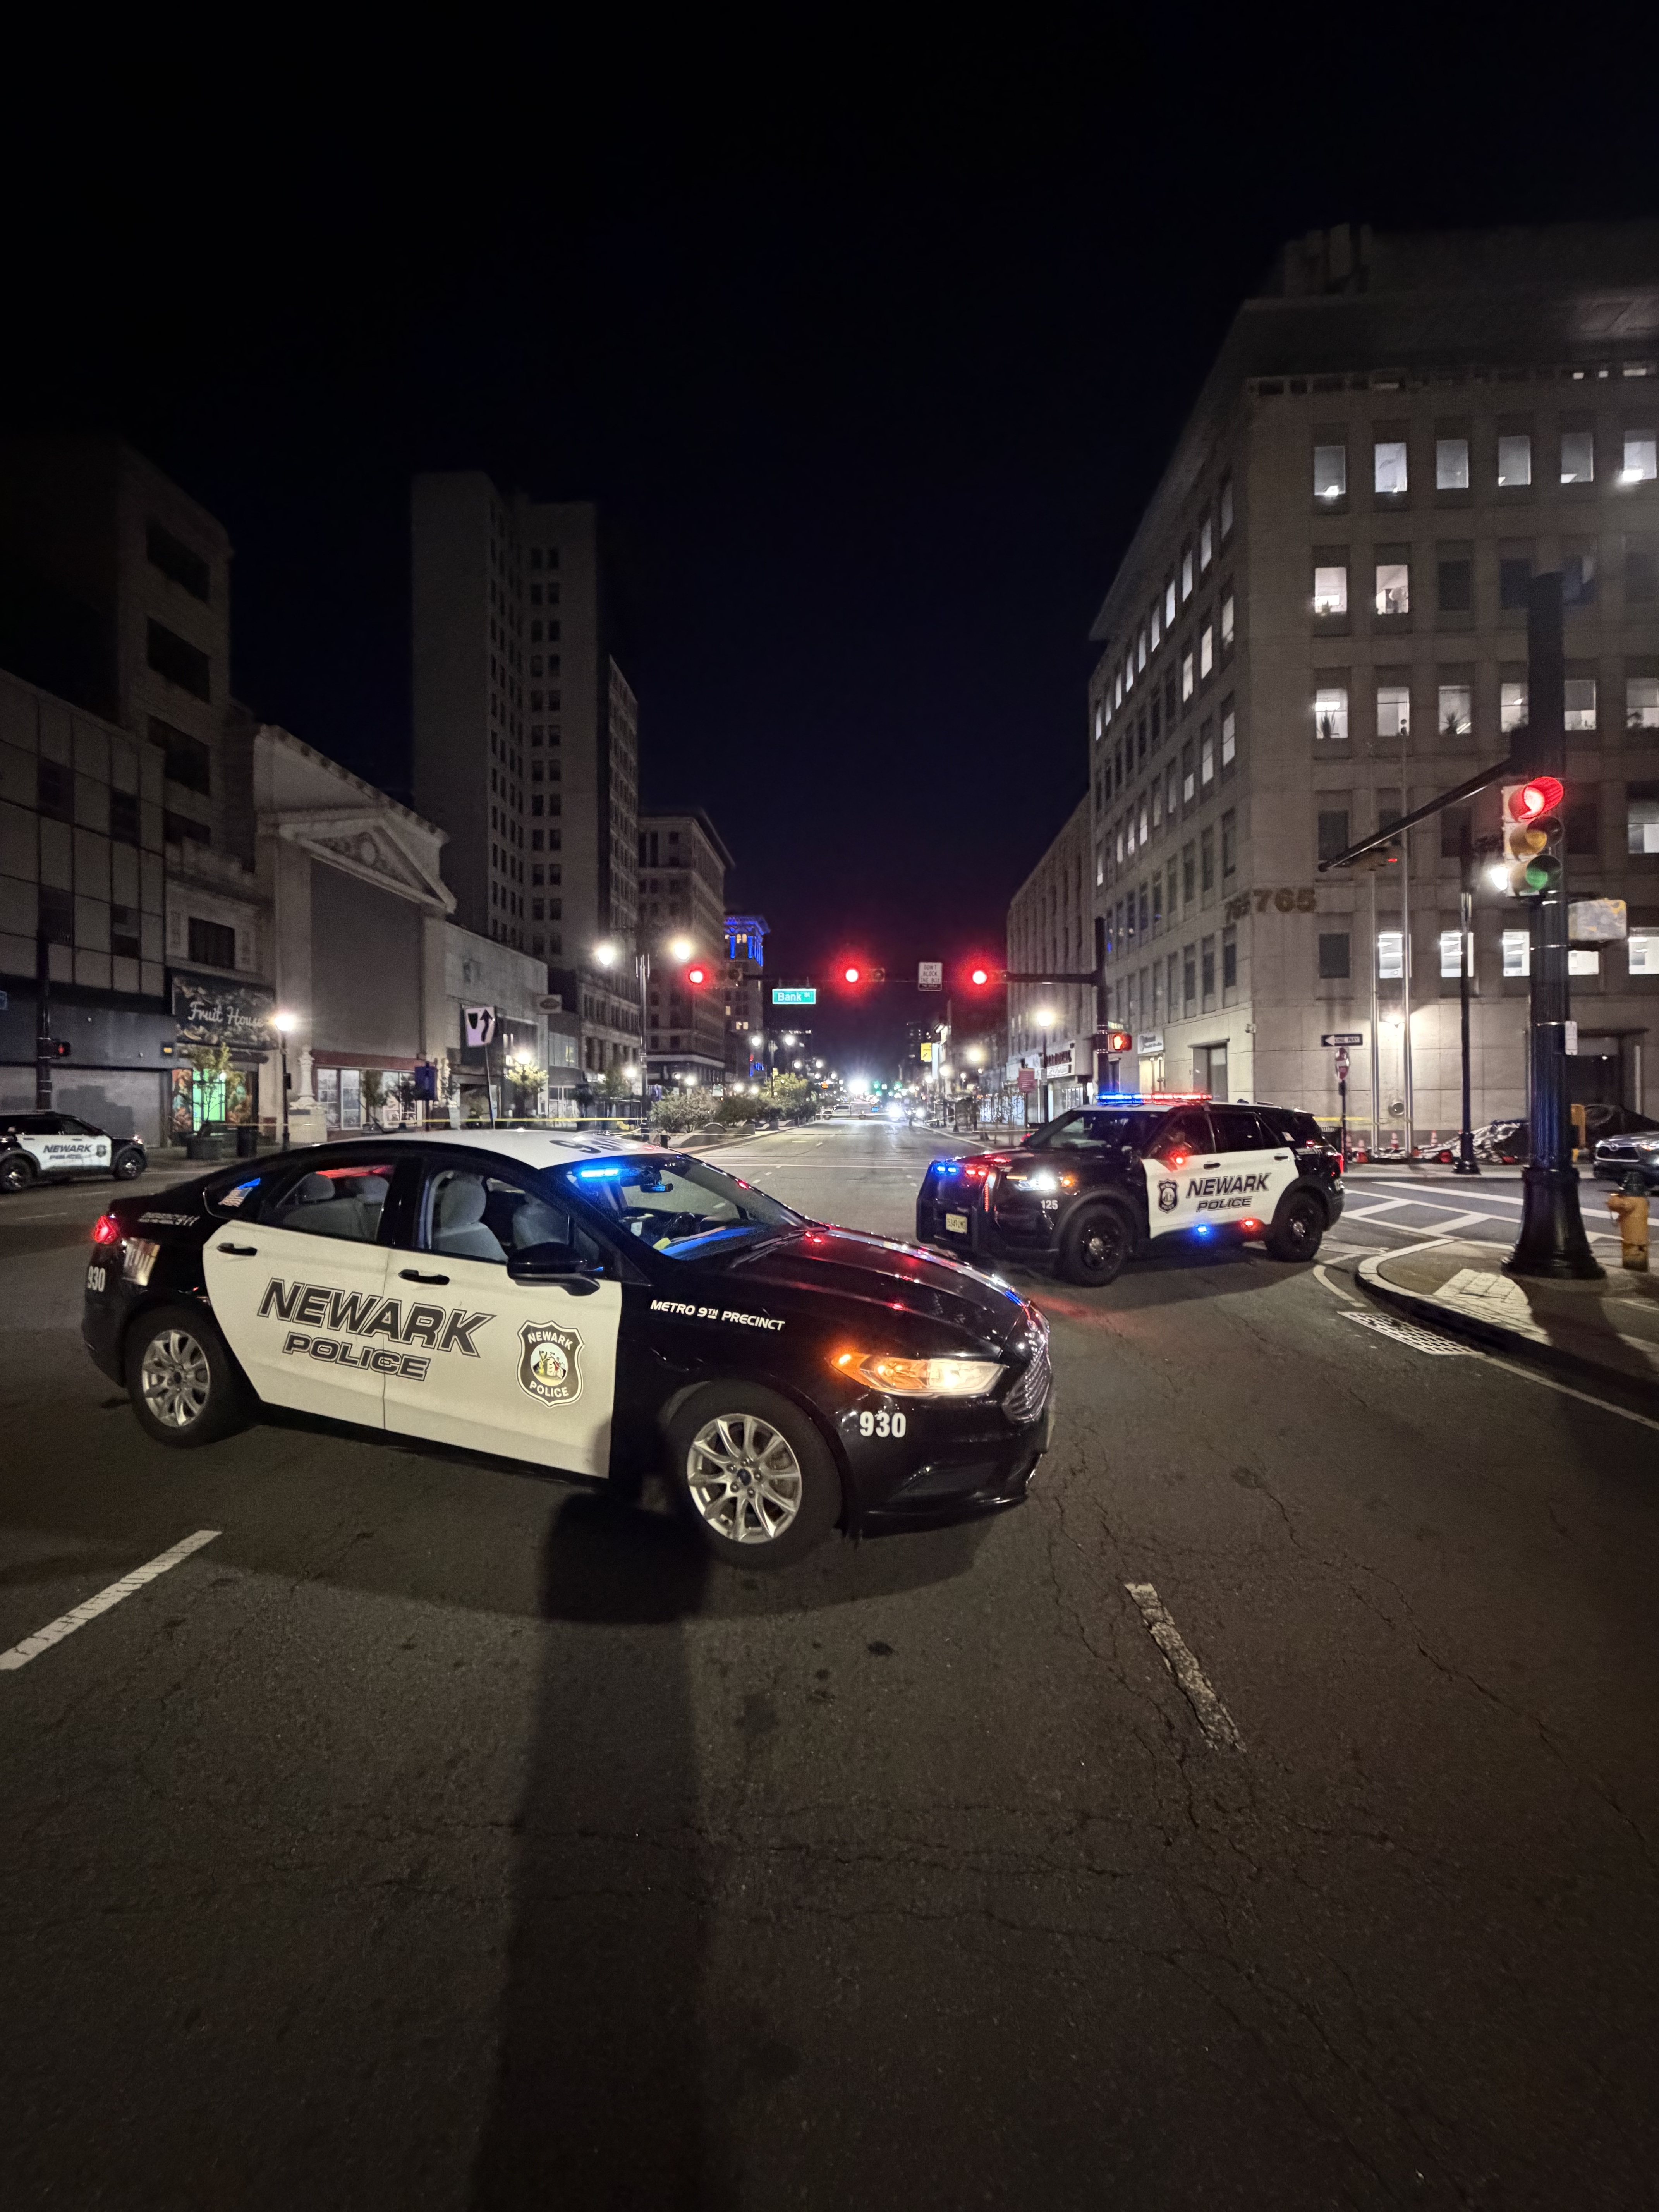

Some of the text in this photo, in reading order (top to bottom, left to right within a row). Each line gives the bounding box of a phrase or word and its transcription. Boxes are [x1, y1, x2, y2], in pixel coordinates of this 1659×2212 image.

[1253, 887, 1316, 913] 765
[778, 992, 802, 1001] Bank
[187, 1001, 265, 1027] Fruit House
[43, 1144, 93, 1153] NEWARK
[1186, 1172, 1272, 1199] NEWARK
[1040, 1200, 1058, 1210] 125
[1196, 1196, 1253, 1213] POLICE
[87, 1265, 106, 1293] 930
[257, 1278, 497, 1358] NEWARK
[650, 1300, 786, 1331] METRO 9TH PRECINCT
[527, 1331, 573, 1350] NEWARK
[282, 1331, 431, 1381] POLICE
[529, 1381, 569, 1398] POLICE
[859, 1411, 906, 1438] 930
